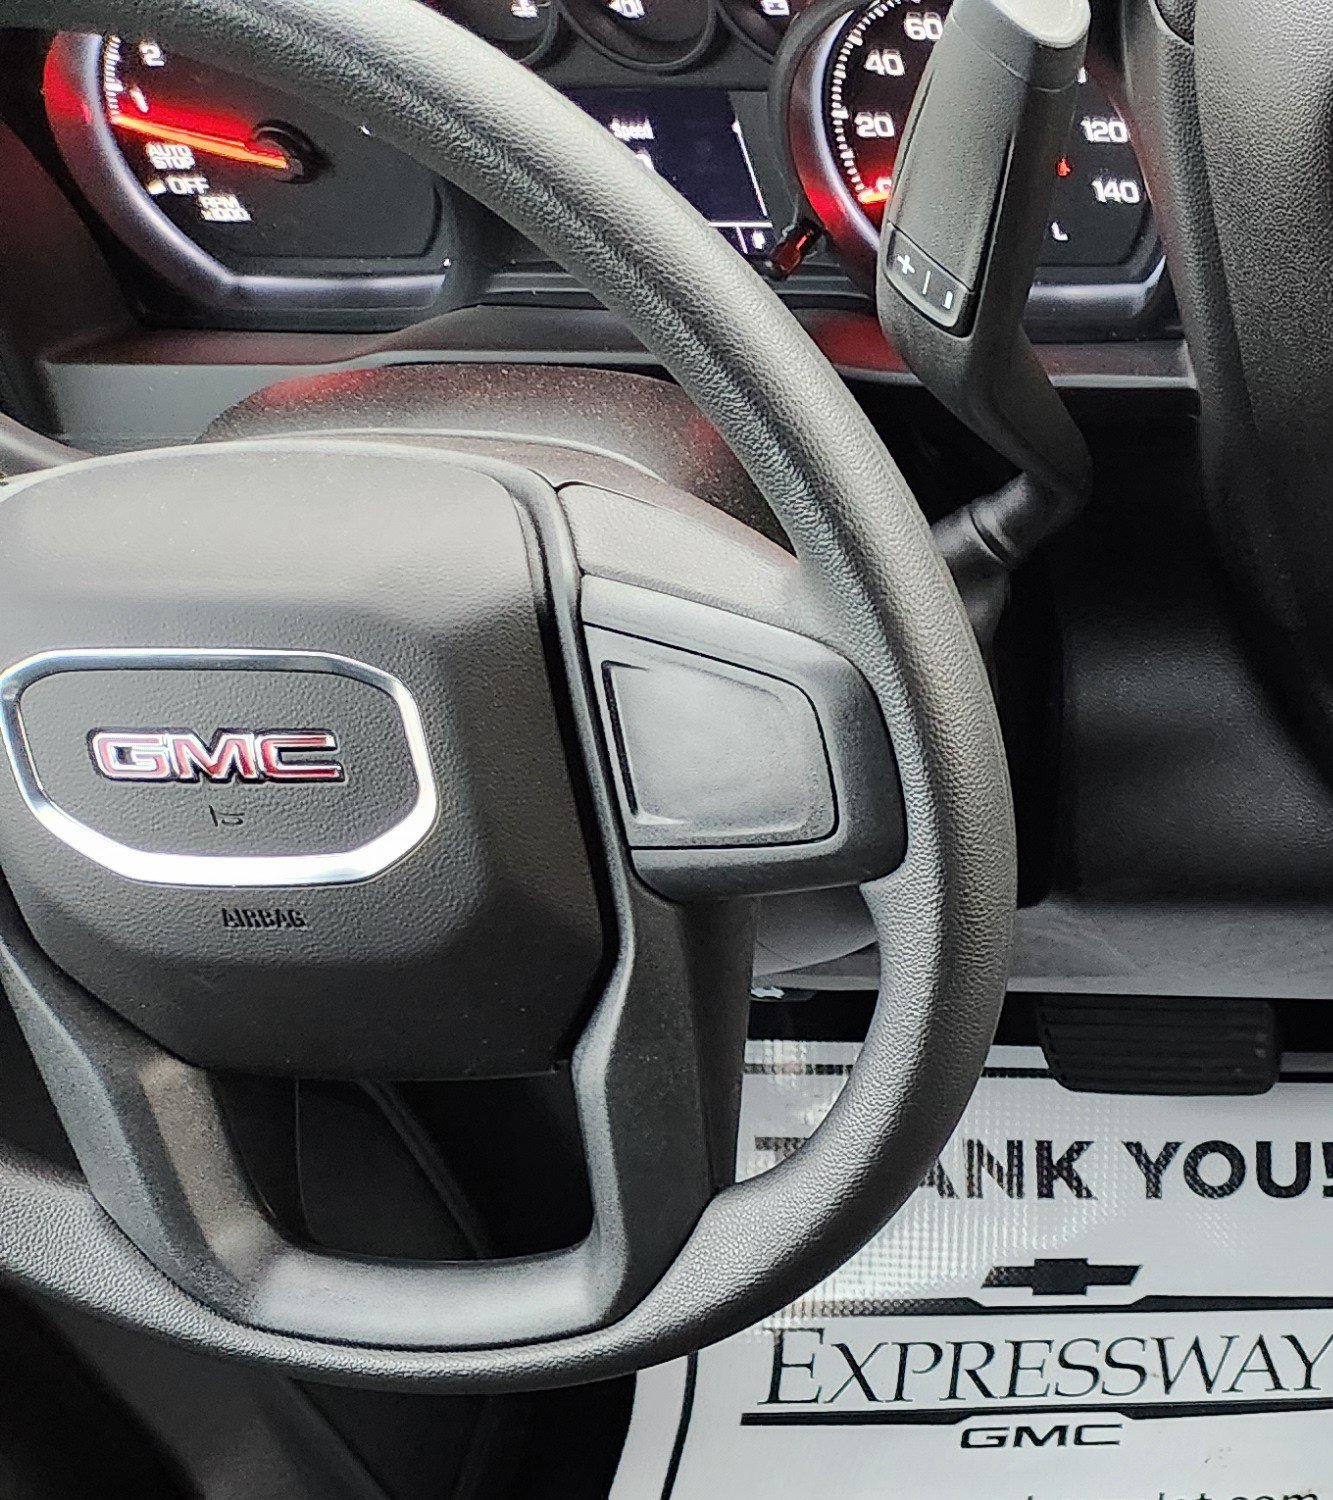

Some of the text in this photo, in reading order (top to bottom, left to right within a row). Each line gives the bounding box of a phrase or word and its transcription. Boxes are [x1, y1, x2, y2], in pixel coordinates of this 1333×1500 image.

[905, 14, 943, 40] 60
[864, 52, 904, 76] 40
[855, 113, 895, 138] 20
[1081, 116, 1131, 143] 120
[146, 141, 193, 158] AUTO
[165, 173, 210, 195] OFF
[1091, 178, 1141, 204] 140
[90, 729, 345, 783] GMC
[222, 908, 307, 929] AIRBAG
[960, 1422, 1122, 1449] GMC
